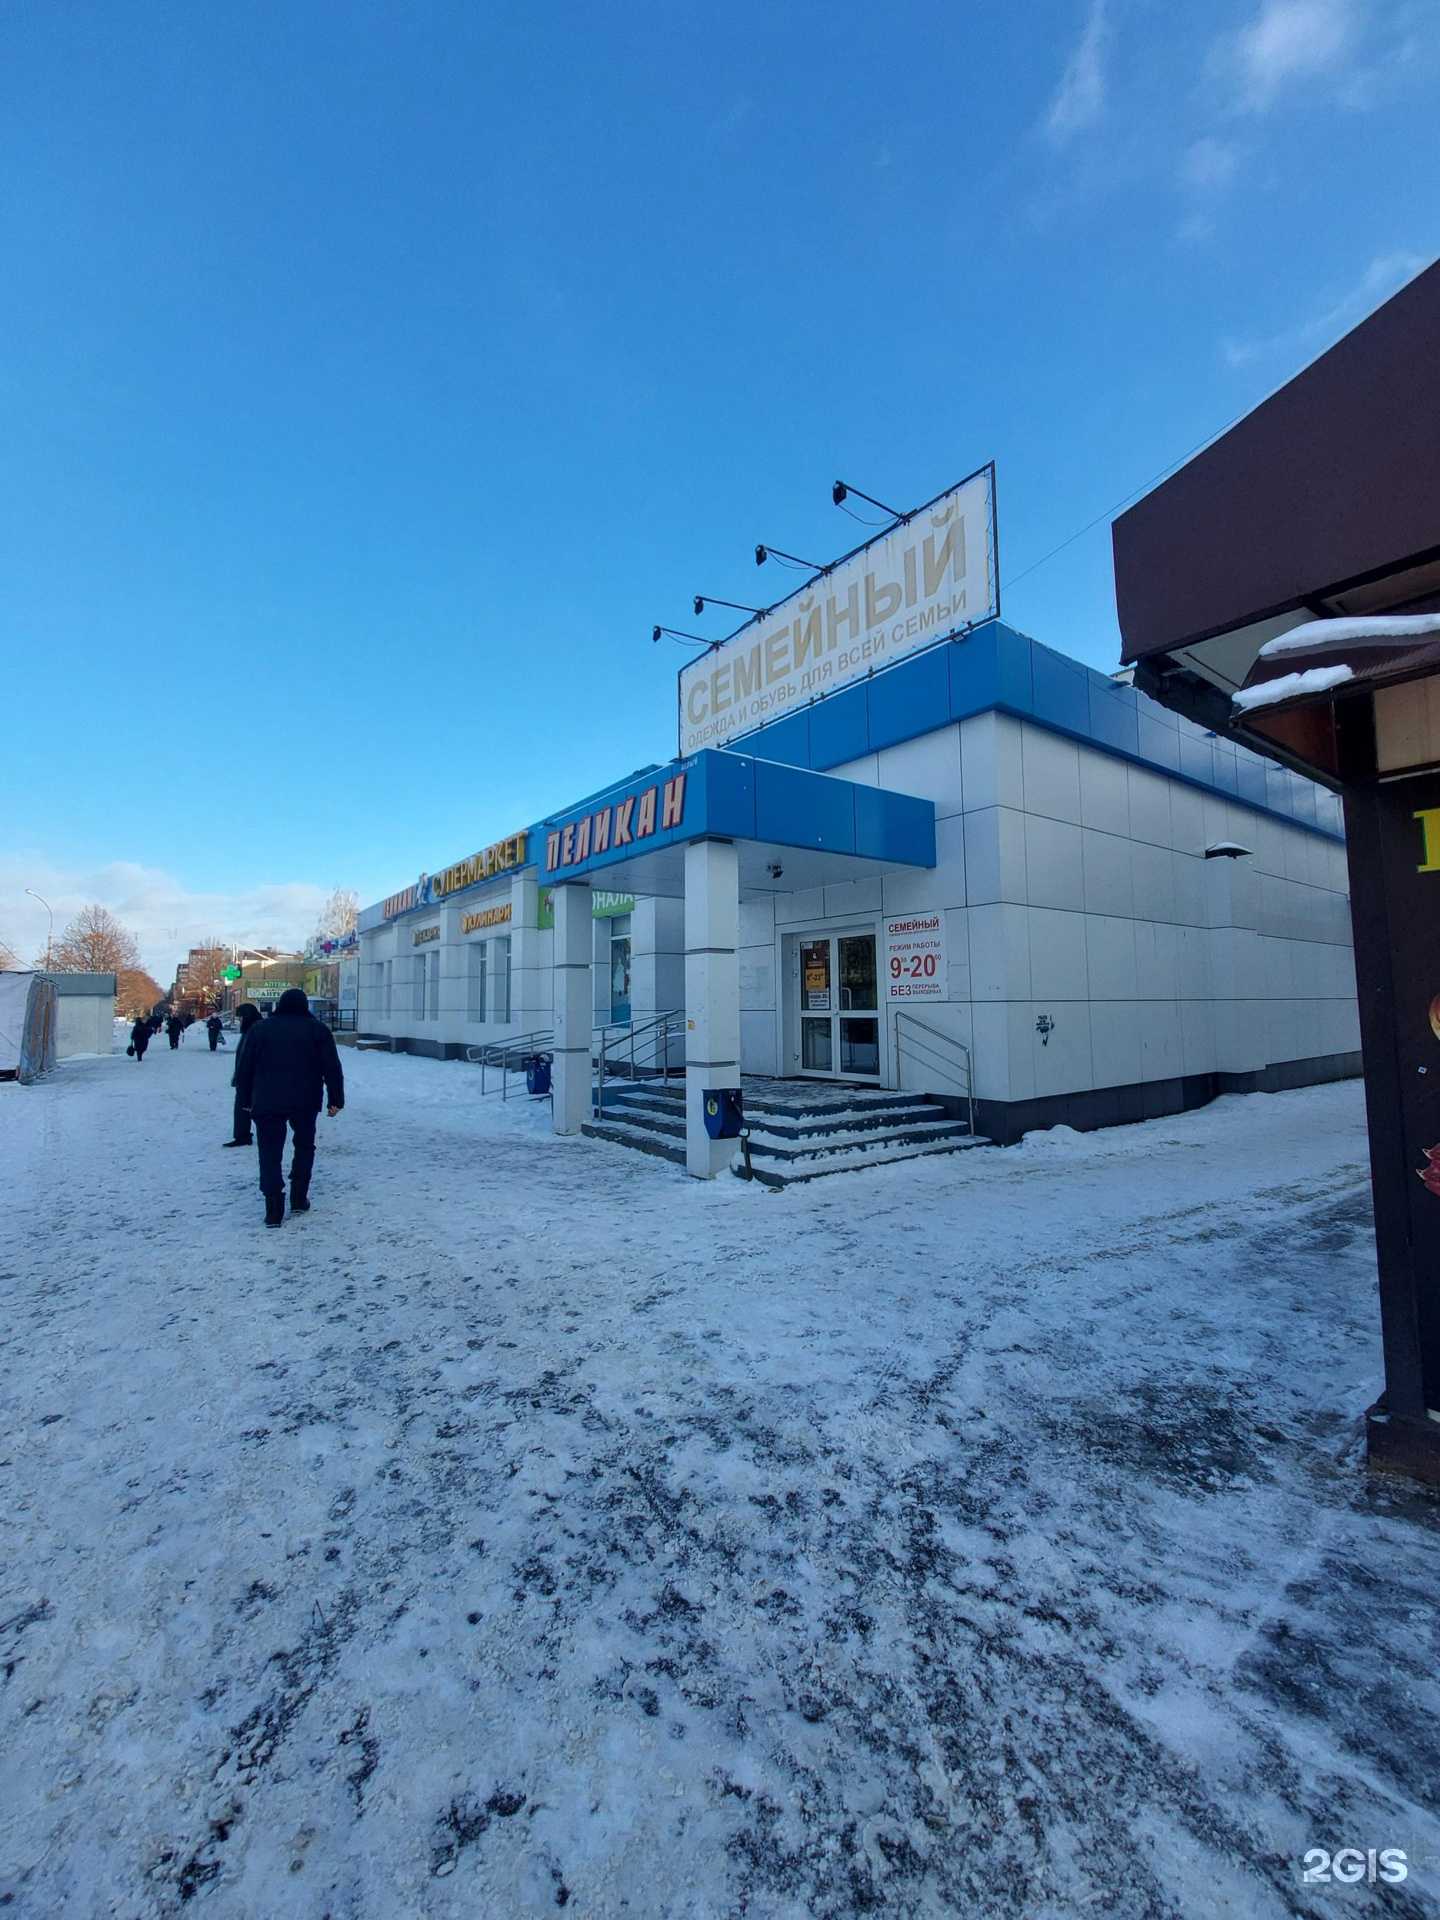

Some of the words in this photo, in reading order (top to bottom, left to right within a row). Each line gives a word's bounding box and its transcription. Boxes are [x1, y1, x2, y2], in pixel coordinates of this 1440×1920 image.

[686, 504, 967, 725] СЕМЕЙНЫЙ
[687, 714, 736, 748] ОДЕЖДА
[738, 708, 748, 723] И
[750, 682, 797, 716] ОБУВЬ
[799, 661, 833, 694] ДЛЯ
[837, 632, 886, 672] ВСЕЙ
[891, 589, 968, 644] СЕМЬИ
[546, 773, 686, 872] ПЕЛИКАН
[431, 831, 528, 897] СУПЕРМАРКЕТ
[888, 916, 940, 933] СЕМЕЙНЫЙ
[891, 984, 911, 996] БЕЗ
